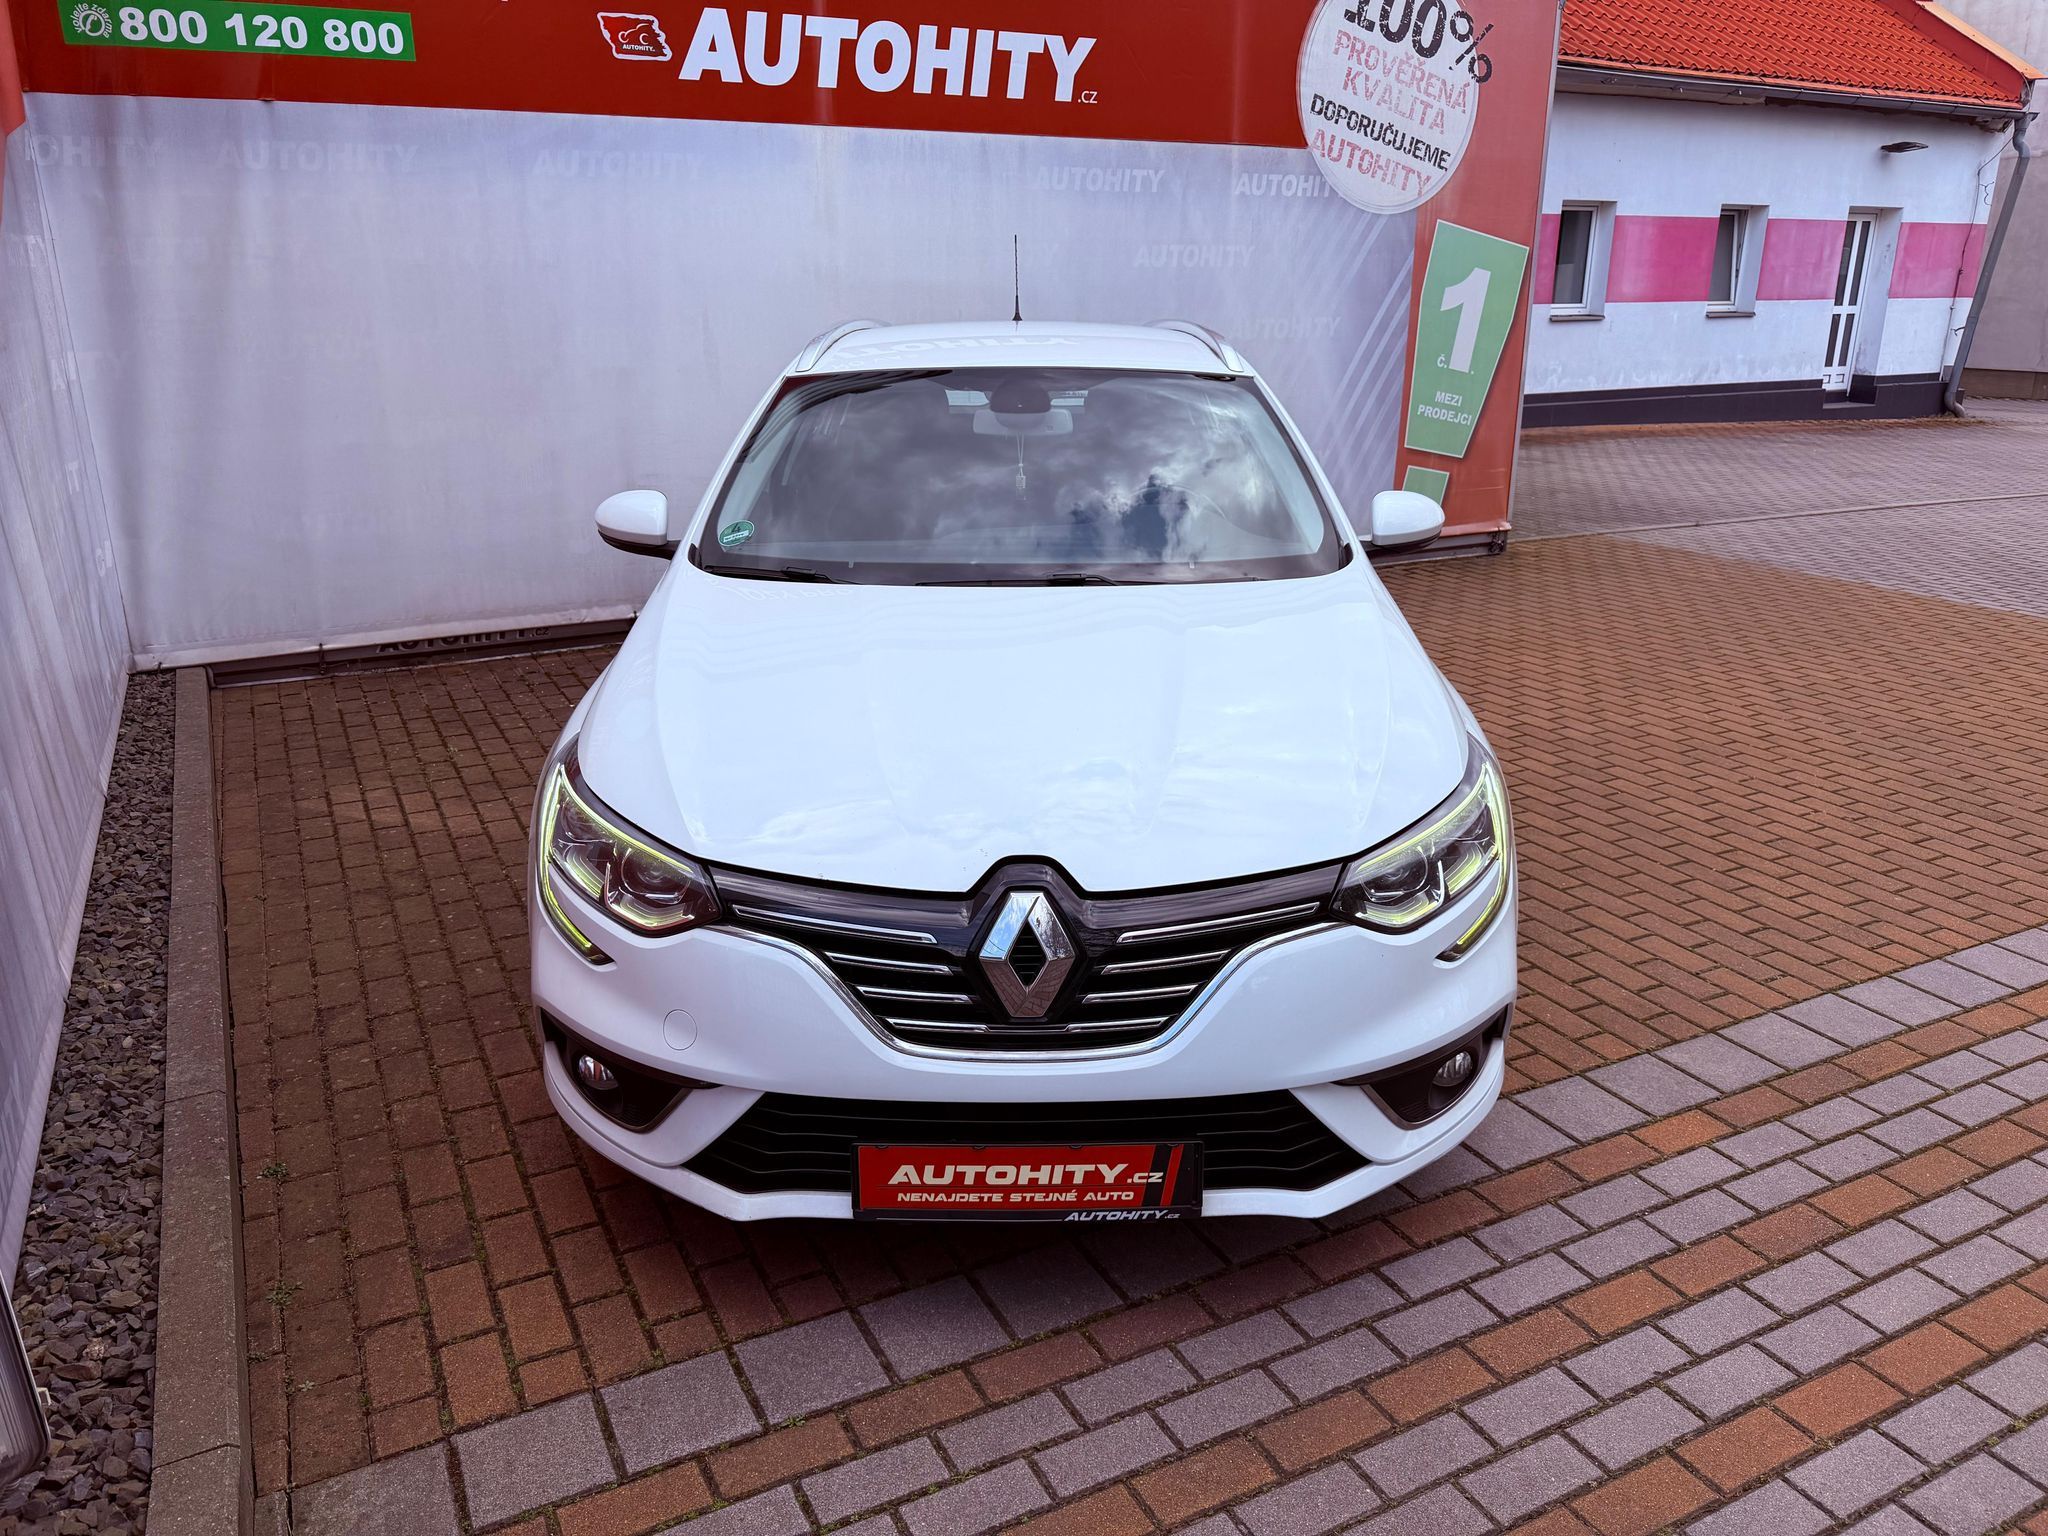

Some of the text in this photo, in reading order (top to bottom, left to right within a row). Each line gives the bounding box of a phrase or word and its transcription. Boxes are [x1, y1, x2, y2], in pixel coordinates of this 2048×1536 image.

[70, 2, 113, 38] volejte zdarma
[118, 6, 405, 55] 800 120 800
[1332, 29, 1471, 114] PROVĚŘENÁ
[1342, 66, 1445, 135] KVALITA
[1310, 93, 1452, 172] DOPORUČUJEME
[213, 139, 419, 173] AUTOHITY
[531, 148, 708, 181] AUTOHITY
[1310, 128, 1432, 198] AUTOHITY
[1034, 167, 1166, 194] AUTOHITY
[1233, 173, 1343, 199] AUTOHIT
[1133, 245, 1256, 269] AUTOHITY
[1434, 390, 1463, 407] MEZI
[1416, 404, 1473, 426] PRODEJCI
[887, 1163, 1164, 1186] AUTOHITY.cz
[897, 1189, 1135, 1203] NENAJDETE STEJNÉ AUTO
[1064, 1209, 1181, 1222] AUTOHITY.cz
